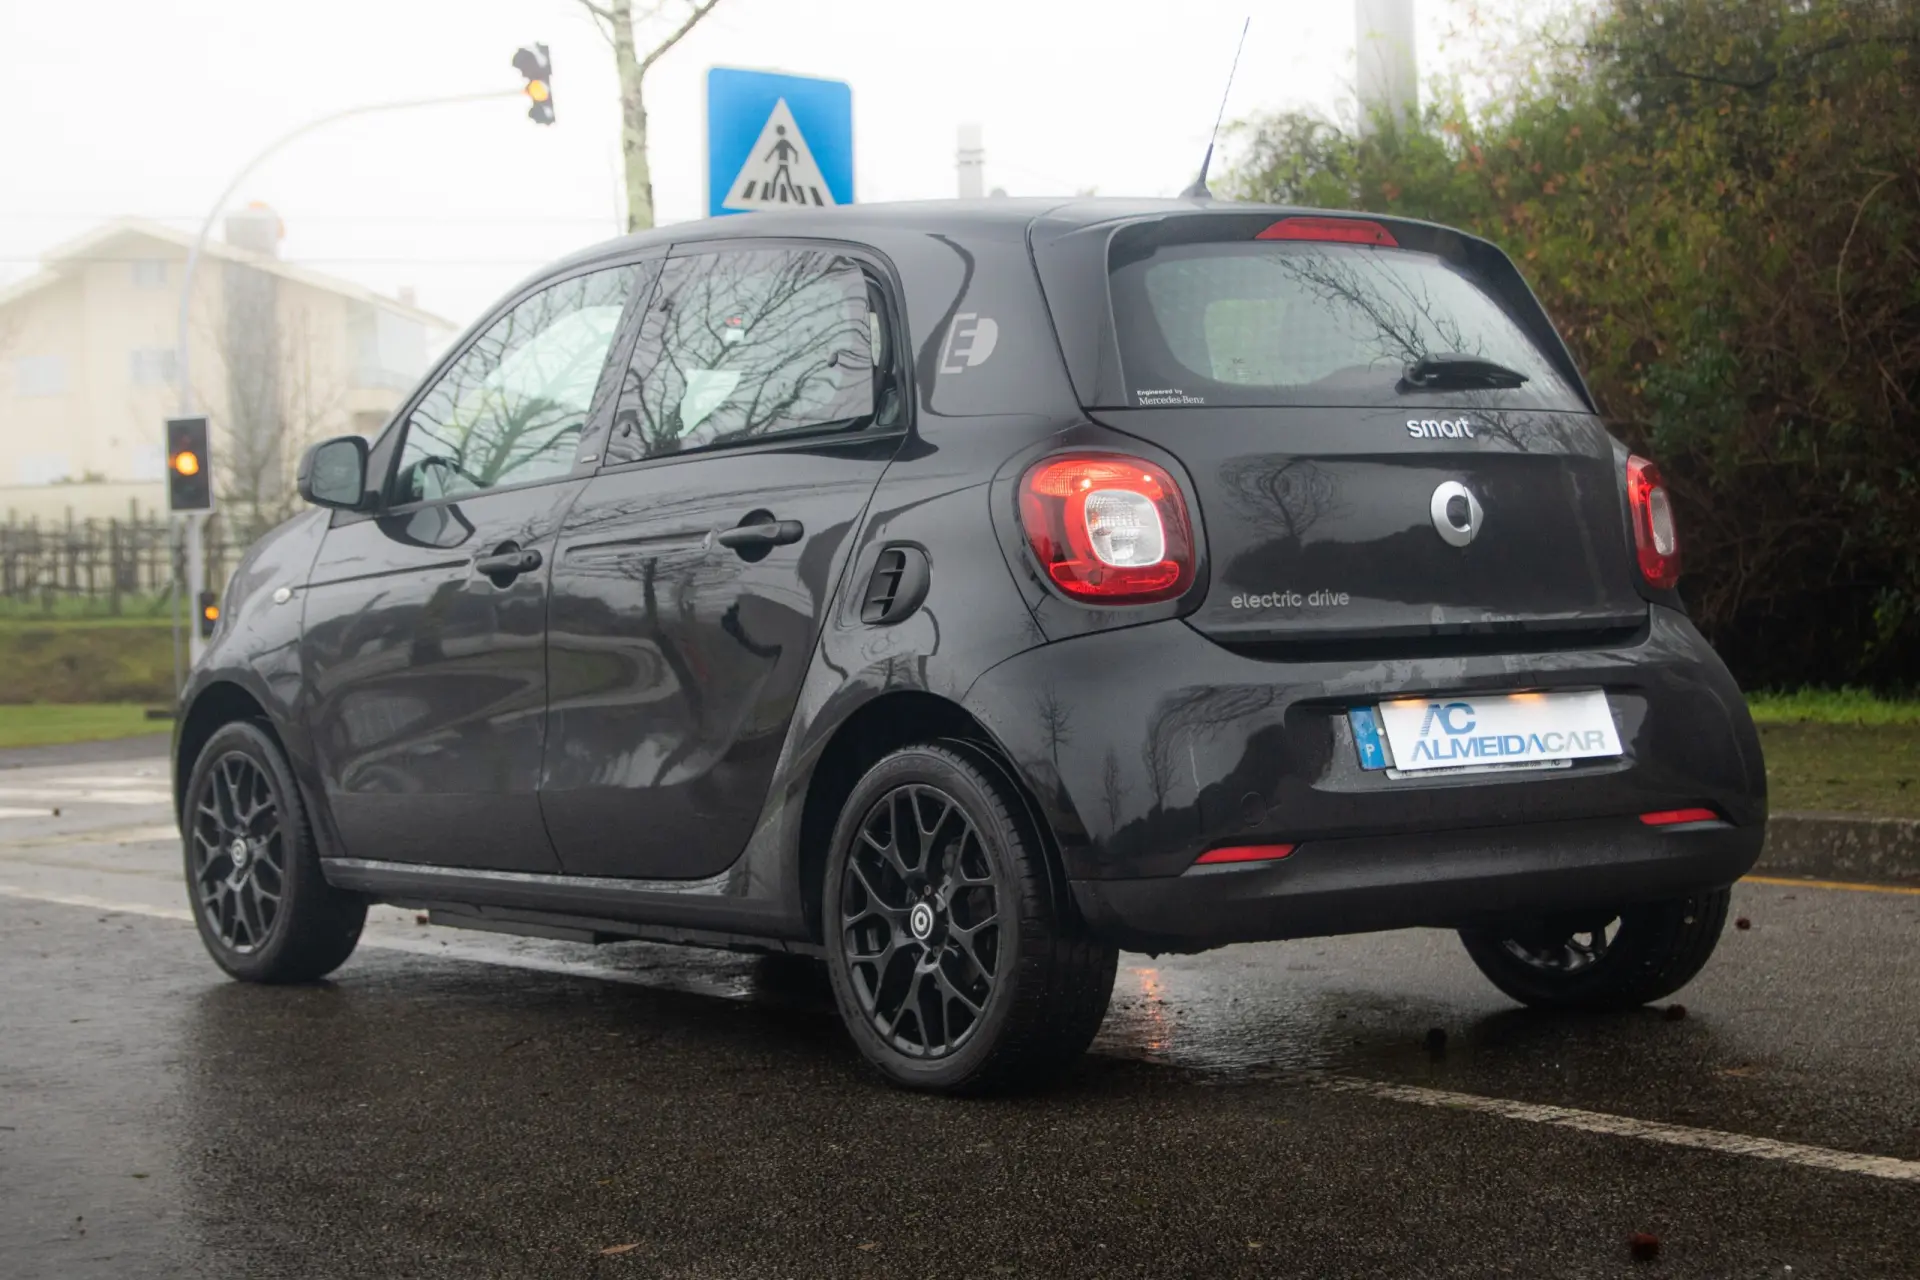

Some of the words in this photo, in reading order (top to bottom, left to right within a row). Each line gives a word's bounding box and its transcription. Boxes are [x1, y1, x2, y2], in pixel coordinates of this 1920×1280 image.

[1139, 395, 1204, 406] Mercedes-Benz
[1406, 415, 1474, 438] smart
[1231, 590, 1302, 609] electric
[1307, 588, 1350, 606] drive
[1420, 702, 1476, 737] AC
[1365, 743, 1375, 758] P
[1411, 730, 1606, 762] ALMEIDACAR
